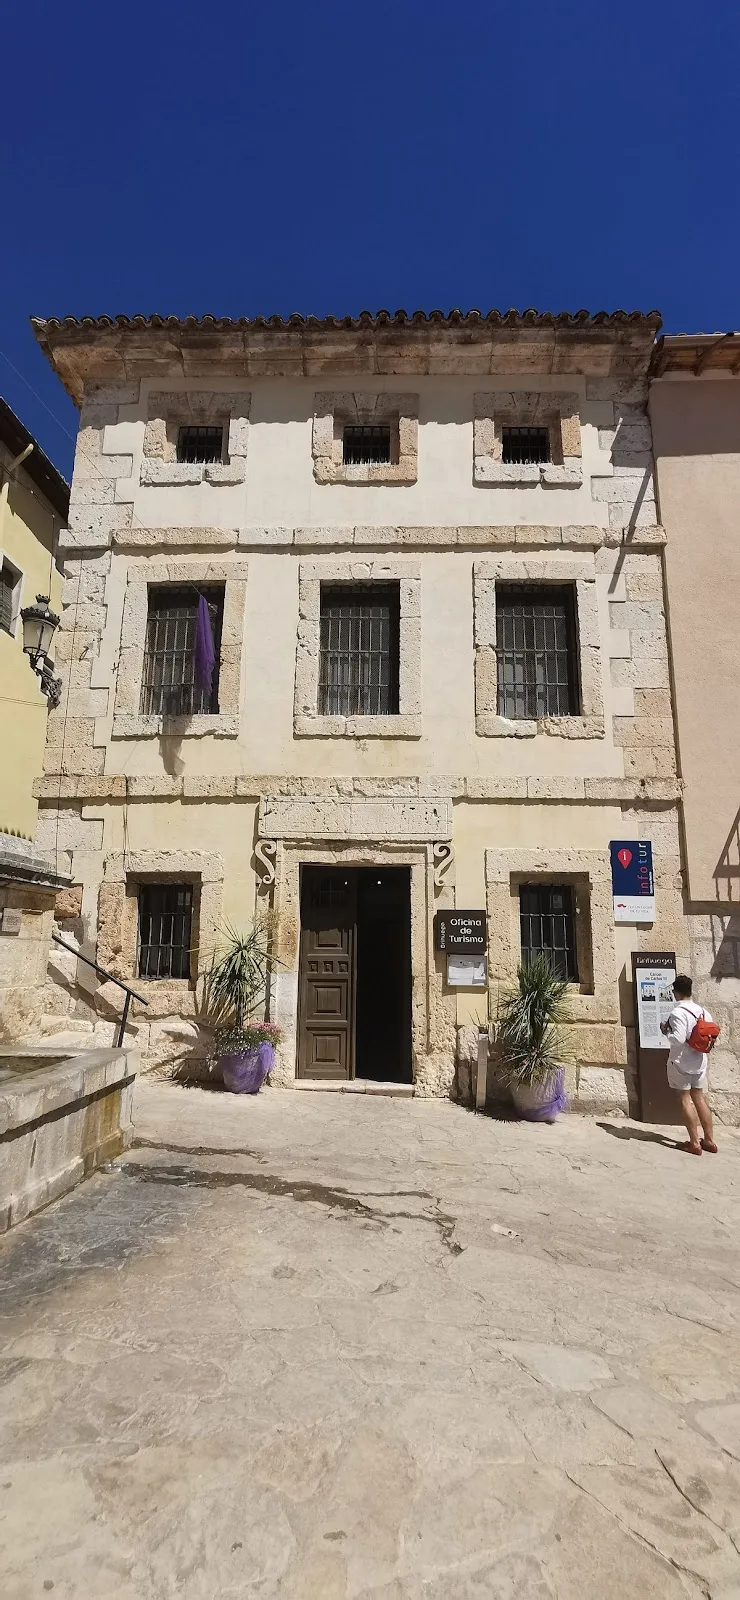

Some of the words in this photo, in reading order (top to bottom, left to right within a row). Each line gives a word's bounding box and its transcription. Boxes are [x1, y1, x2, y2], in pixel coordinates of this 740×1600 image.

[637, 843, 649, 894] infotur
[450, 918, 482, 926] Oficina
[459, 927, 472, 935] de
[449, 935, 484, 943] Turismo
